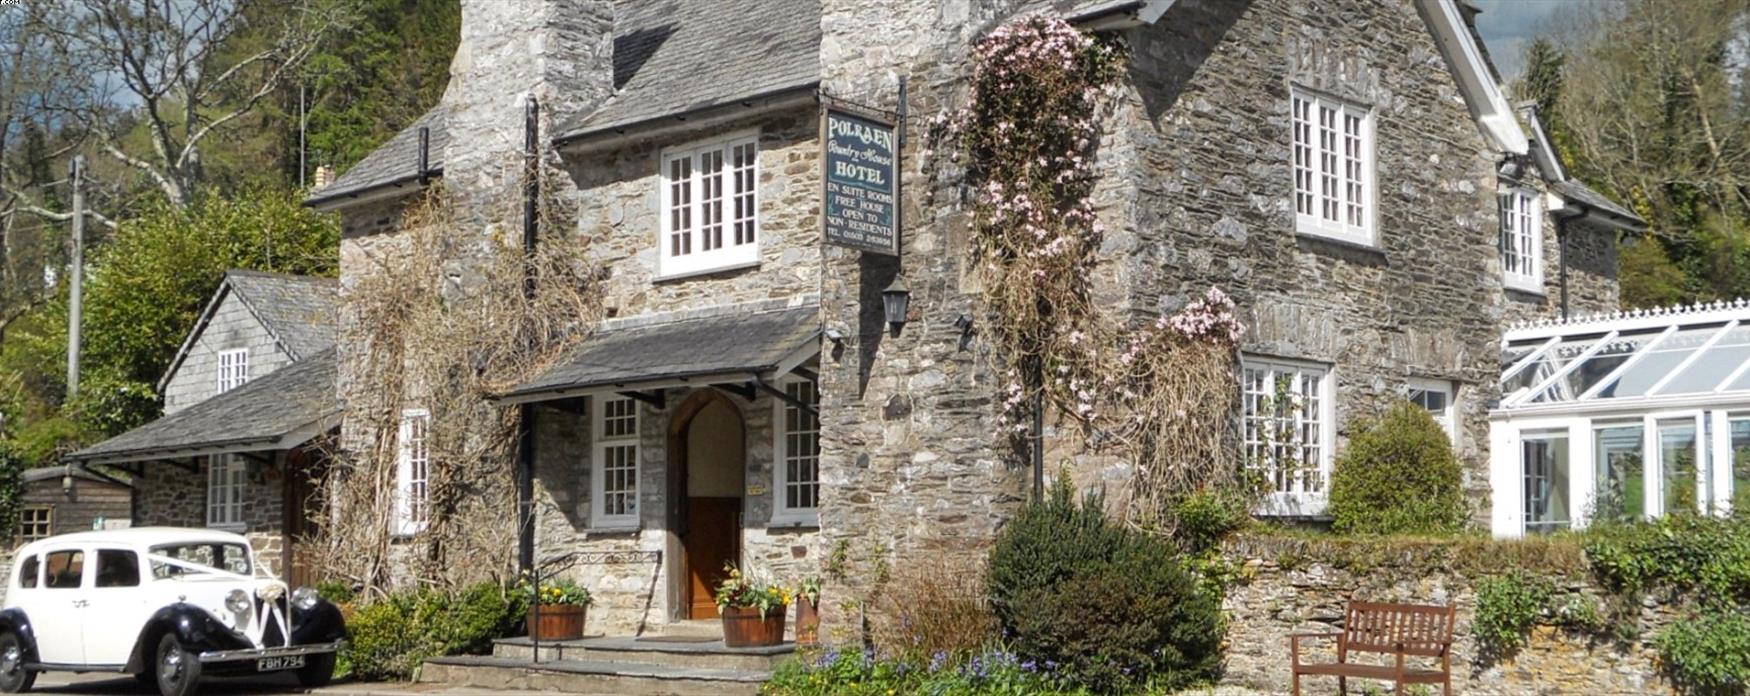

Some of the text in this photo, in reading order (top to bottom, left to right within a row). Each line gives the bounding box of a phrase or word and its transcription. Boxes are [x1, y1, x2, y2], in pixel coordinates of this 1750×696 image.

[829, 117, 893, 153] POLRAEN
[828, 140, 891, 166] Country House
[835, 161, 885, 185] HOTEL
[827, 182, 892, 204] EN SUITE ROOMS
[835, 196, 885, 214] FREE HOUSE
[842, 208, 878, 223] OPEN TO
